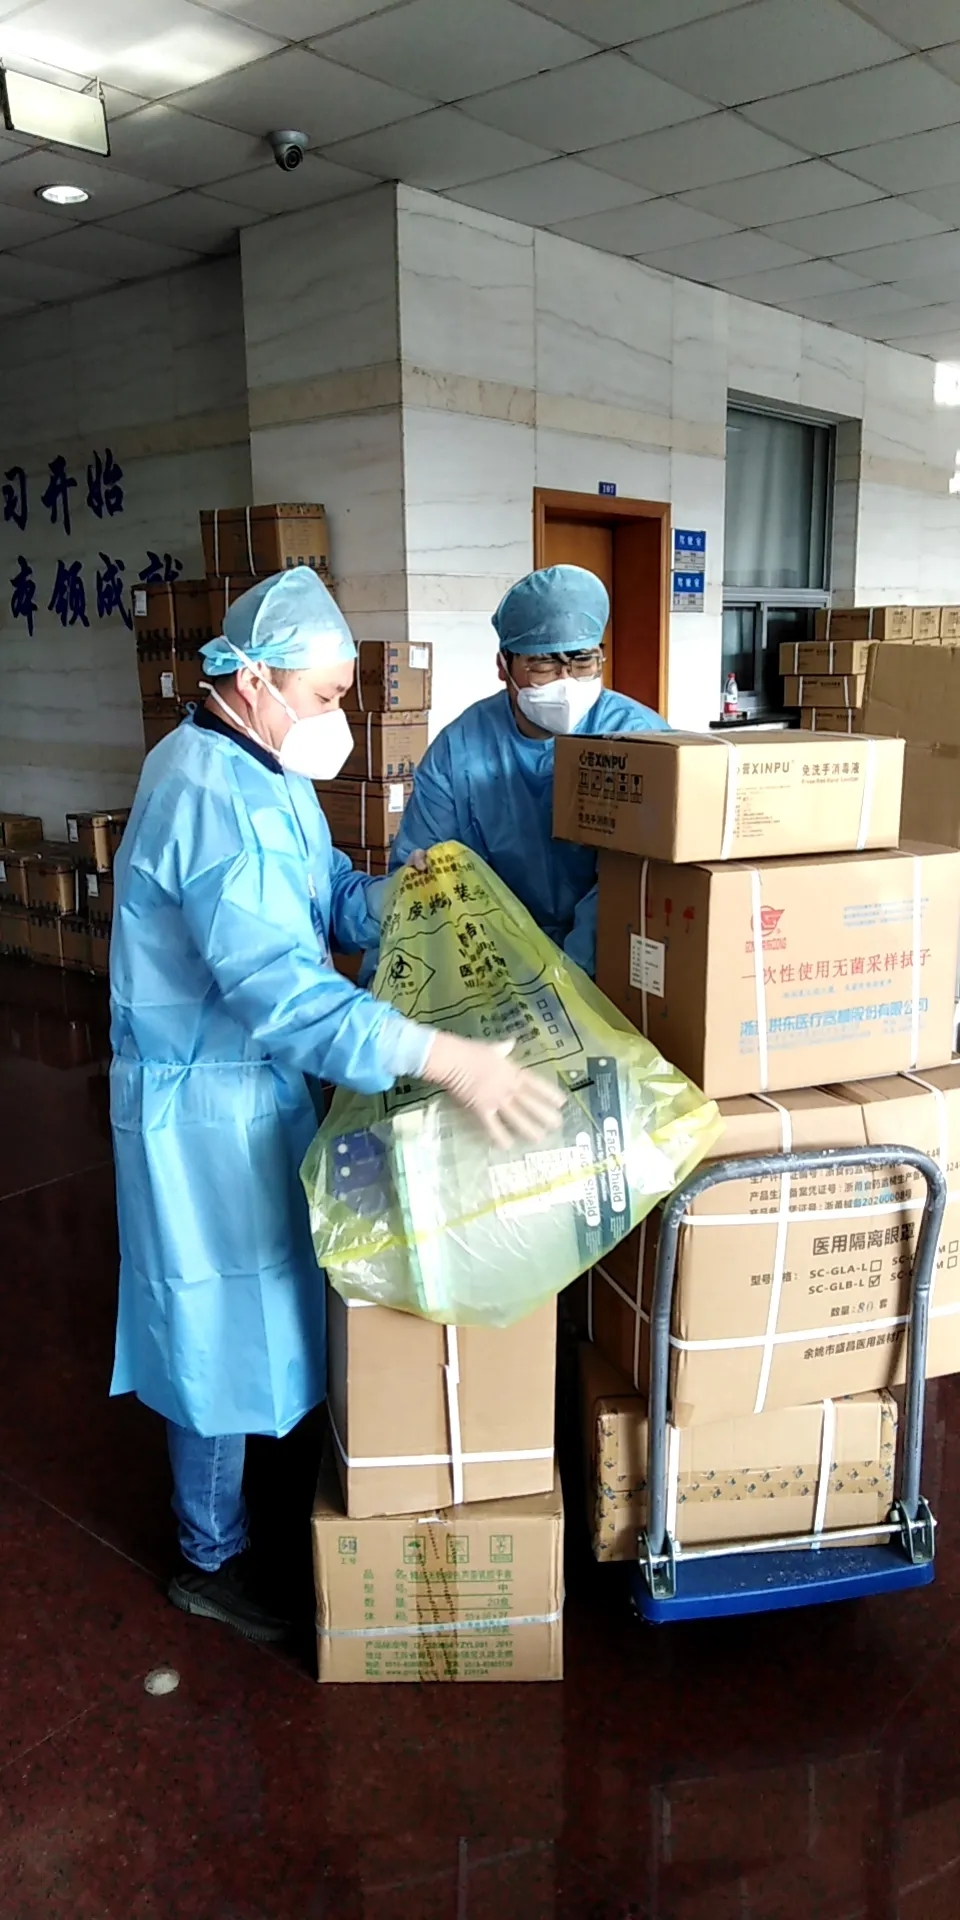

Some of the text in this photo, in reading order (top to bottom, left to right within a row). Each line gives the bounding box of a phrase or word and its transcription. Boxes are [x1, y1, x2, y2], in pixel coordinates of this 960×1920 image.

[802, 762, 860, 777] 免洗手消毒液
[741, 949, 932, 986] 一次性使用无菌采样拭子
[812, 1222, 915, 1257] 医用隔离眼罩
[750, 1271, 799, 1287] 型号格:
[809, 1264, 868, 1279] SC-GLA-L
[808, 1279, 865, 1295] SC-GLB-L
[497, 1582, 509, 1594] 中
